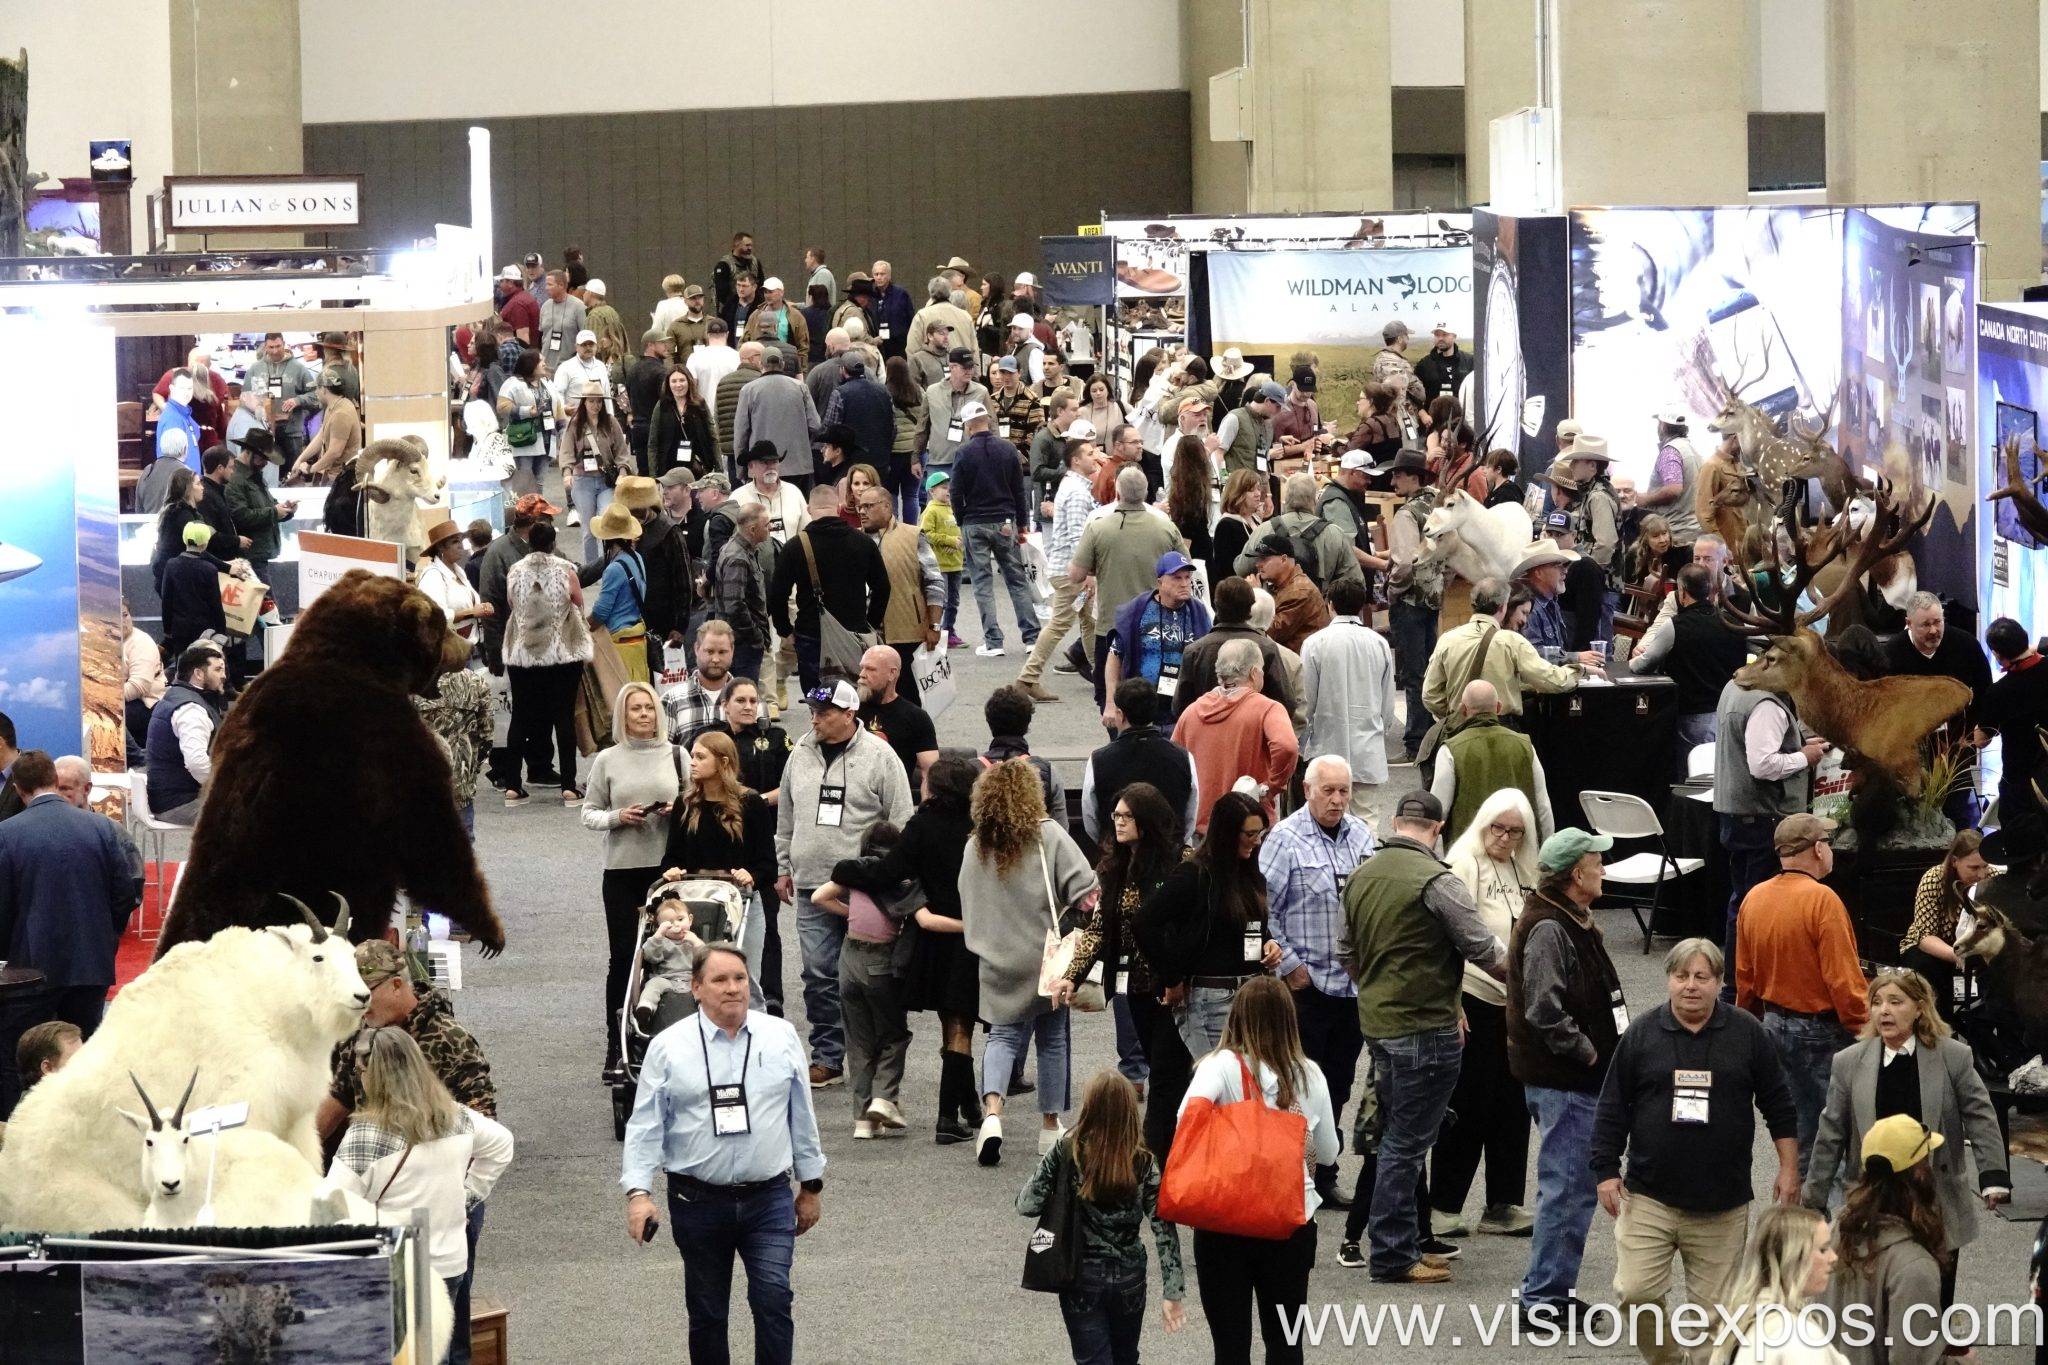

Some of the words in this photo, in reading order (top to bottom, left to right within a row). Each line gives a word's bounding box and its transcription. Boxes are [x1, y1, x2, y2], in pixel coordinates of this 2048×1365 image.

[178, 199, 263, 218] JULIAN
[287, 197, 352, 212] SONS
[1051, 261, 1103, 275] AVANTI
[1287, 278, 1383, 296] WILDMAN
[1330, 302, 1440, 312] ALASKA
[1980, 318, 2005, 340] CANADA
[2006, 324, 2028, 346] NORTH
